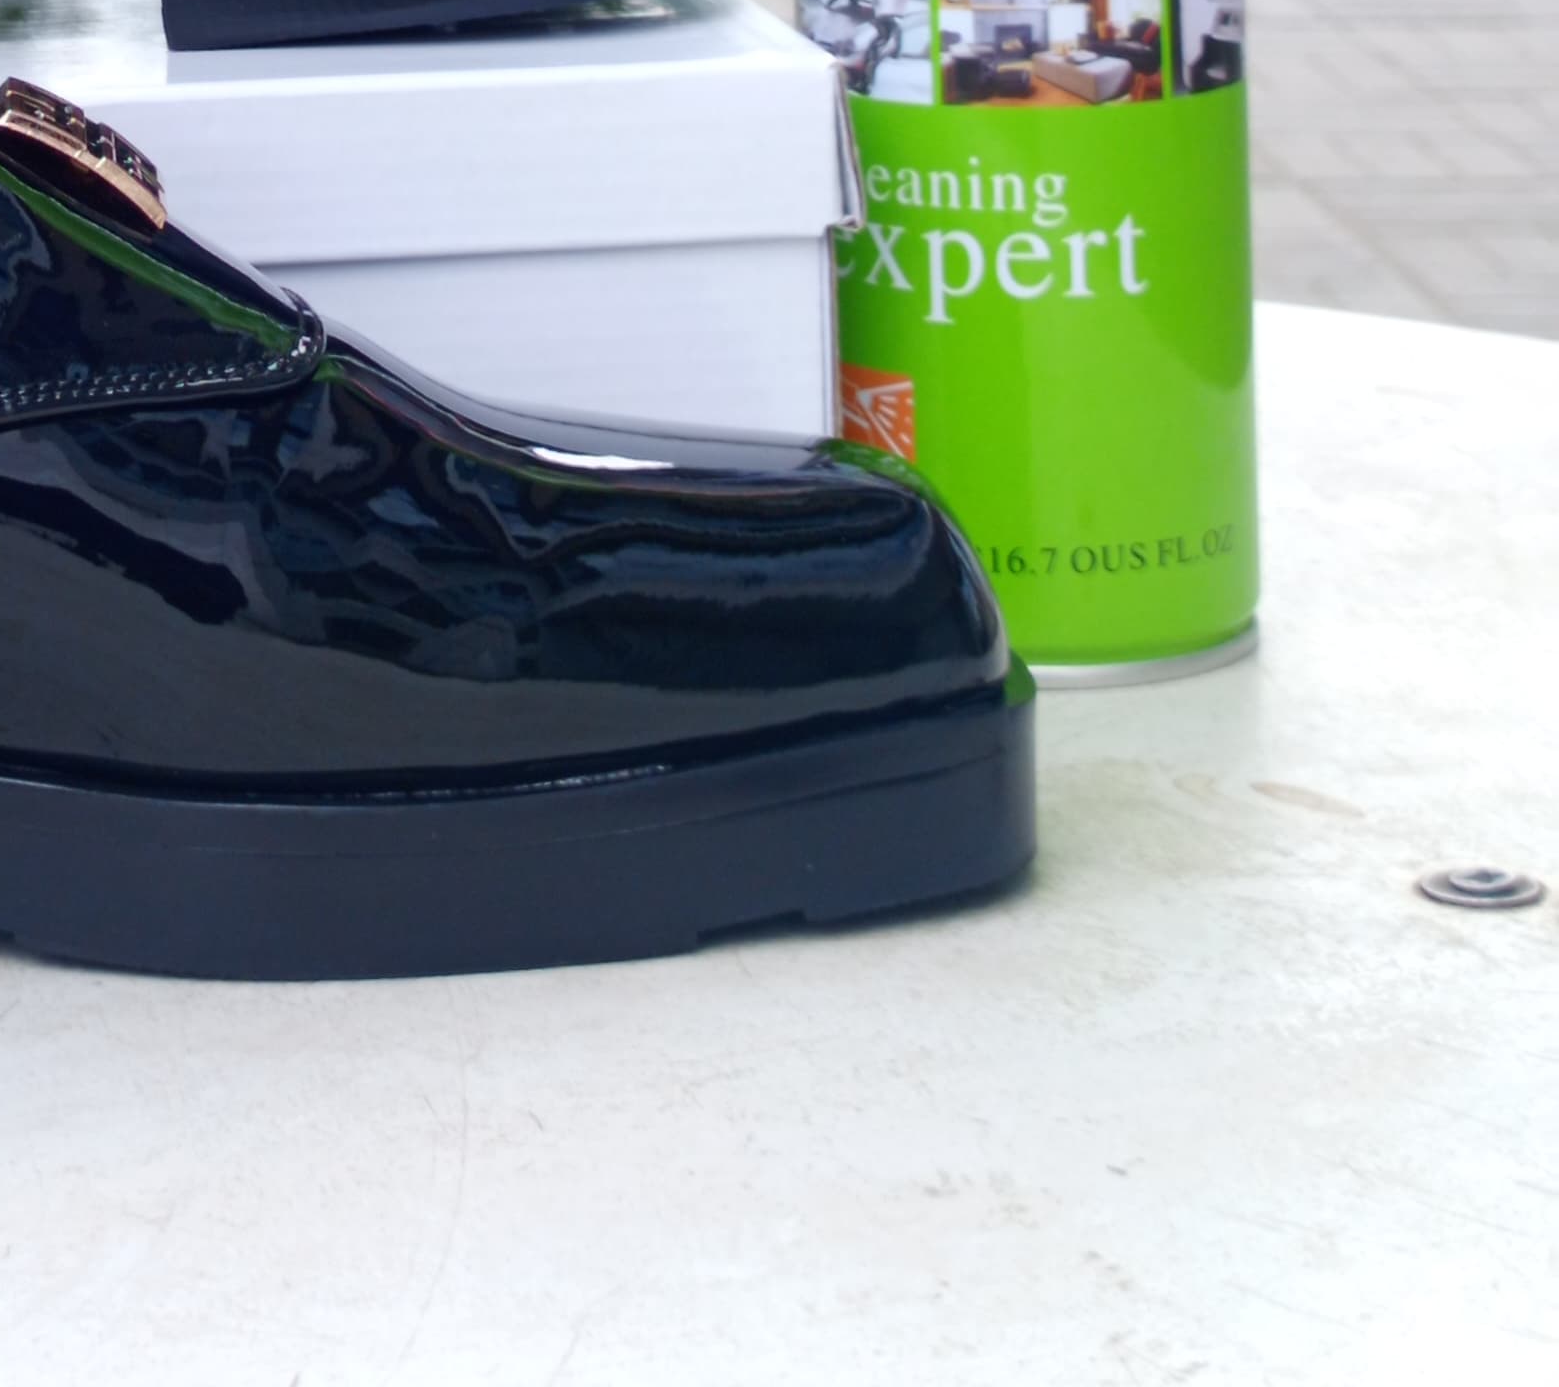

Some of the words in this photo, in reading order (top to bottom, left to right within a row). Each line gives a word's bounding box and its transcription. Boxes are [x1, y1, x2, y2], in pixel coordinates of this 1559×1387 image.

[864, 156, 1069, 228] eaning
[990, 546, 1057, 575] 16.7
[1070, 542, 1148, 575] OUS
